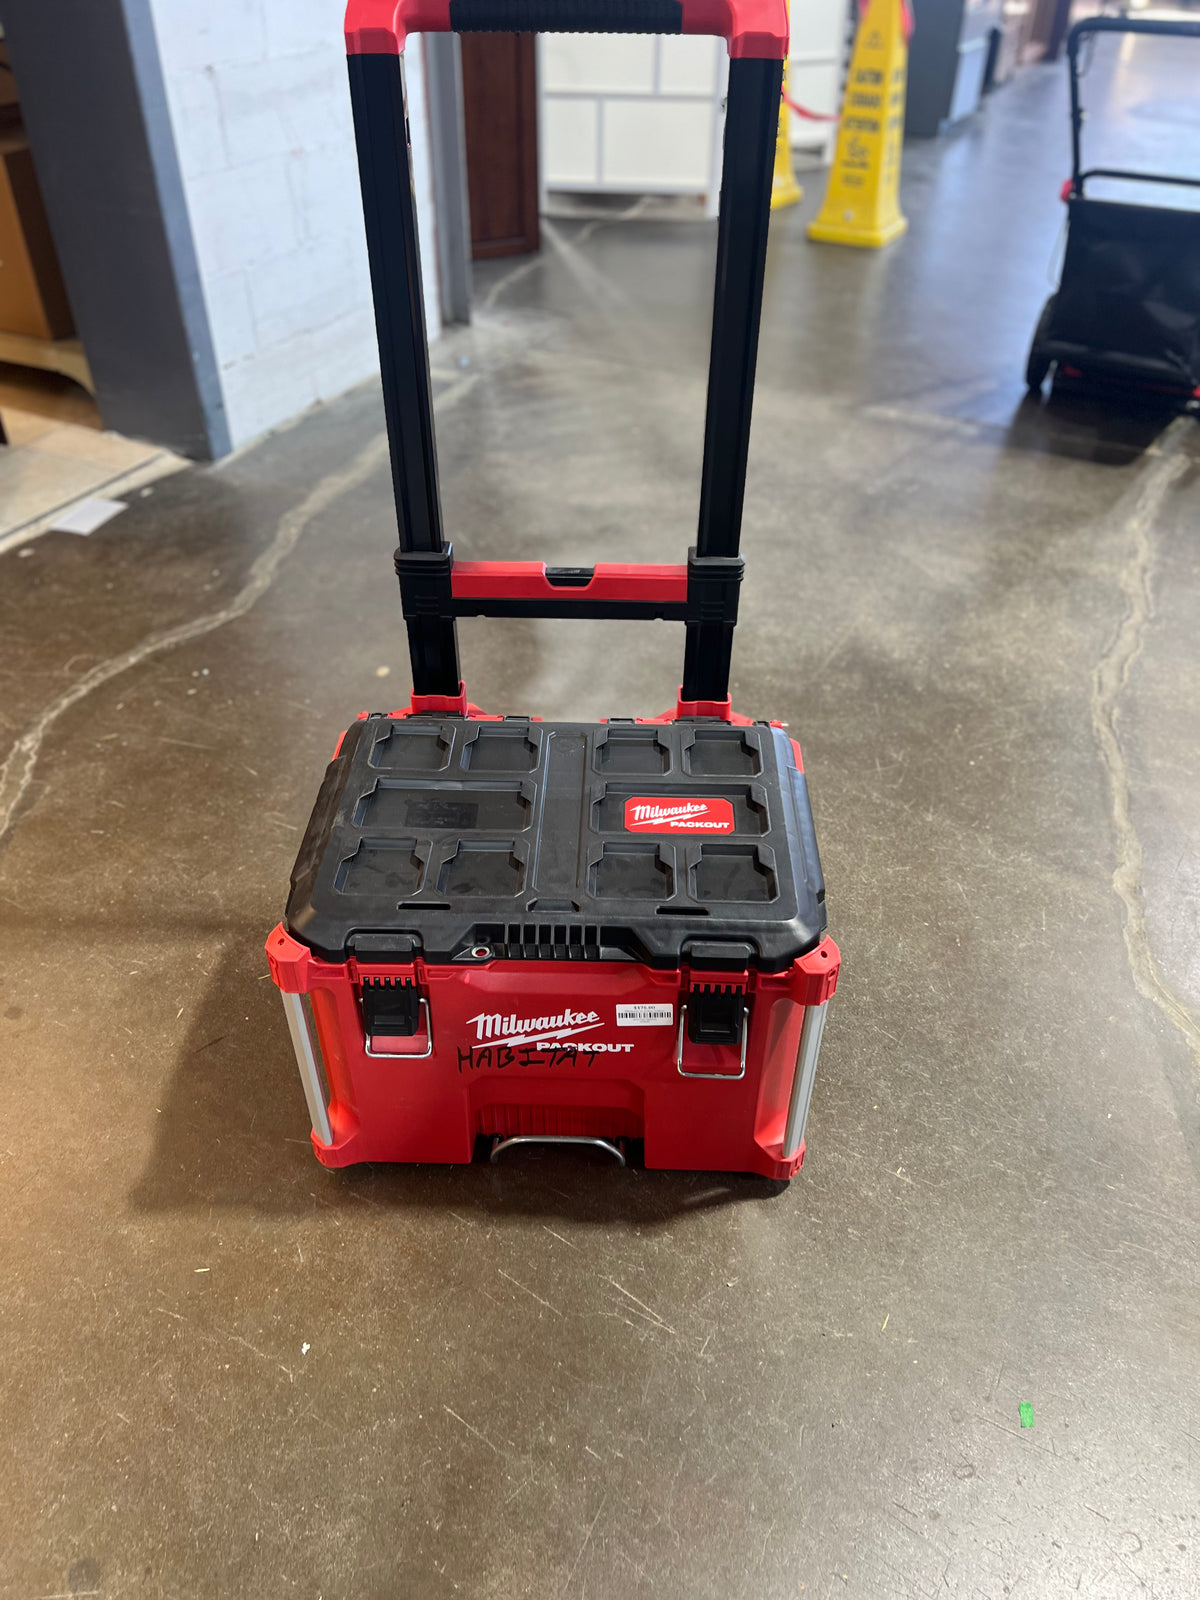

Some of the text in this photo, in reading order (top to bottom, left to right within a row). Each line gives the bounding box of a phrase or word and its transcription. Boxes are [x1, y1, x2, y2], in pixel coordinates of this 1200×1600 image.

[630, 803, 708, 821] Milwaukee
[670, 821, 730, 829] PACKOUT
[466, 1008, 600, 1040] Milwaukee
[536, 1042, 635, 1053] PACKOUT
[457, 1046, 601, 1073] HABITAT
